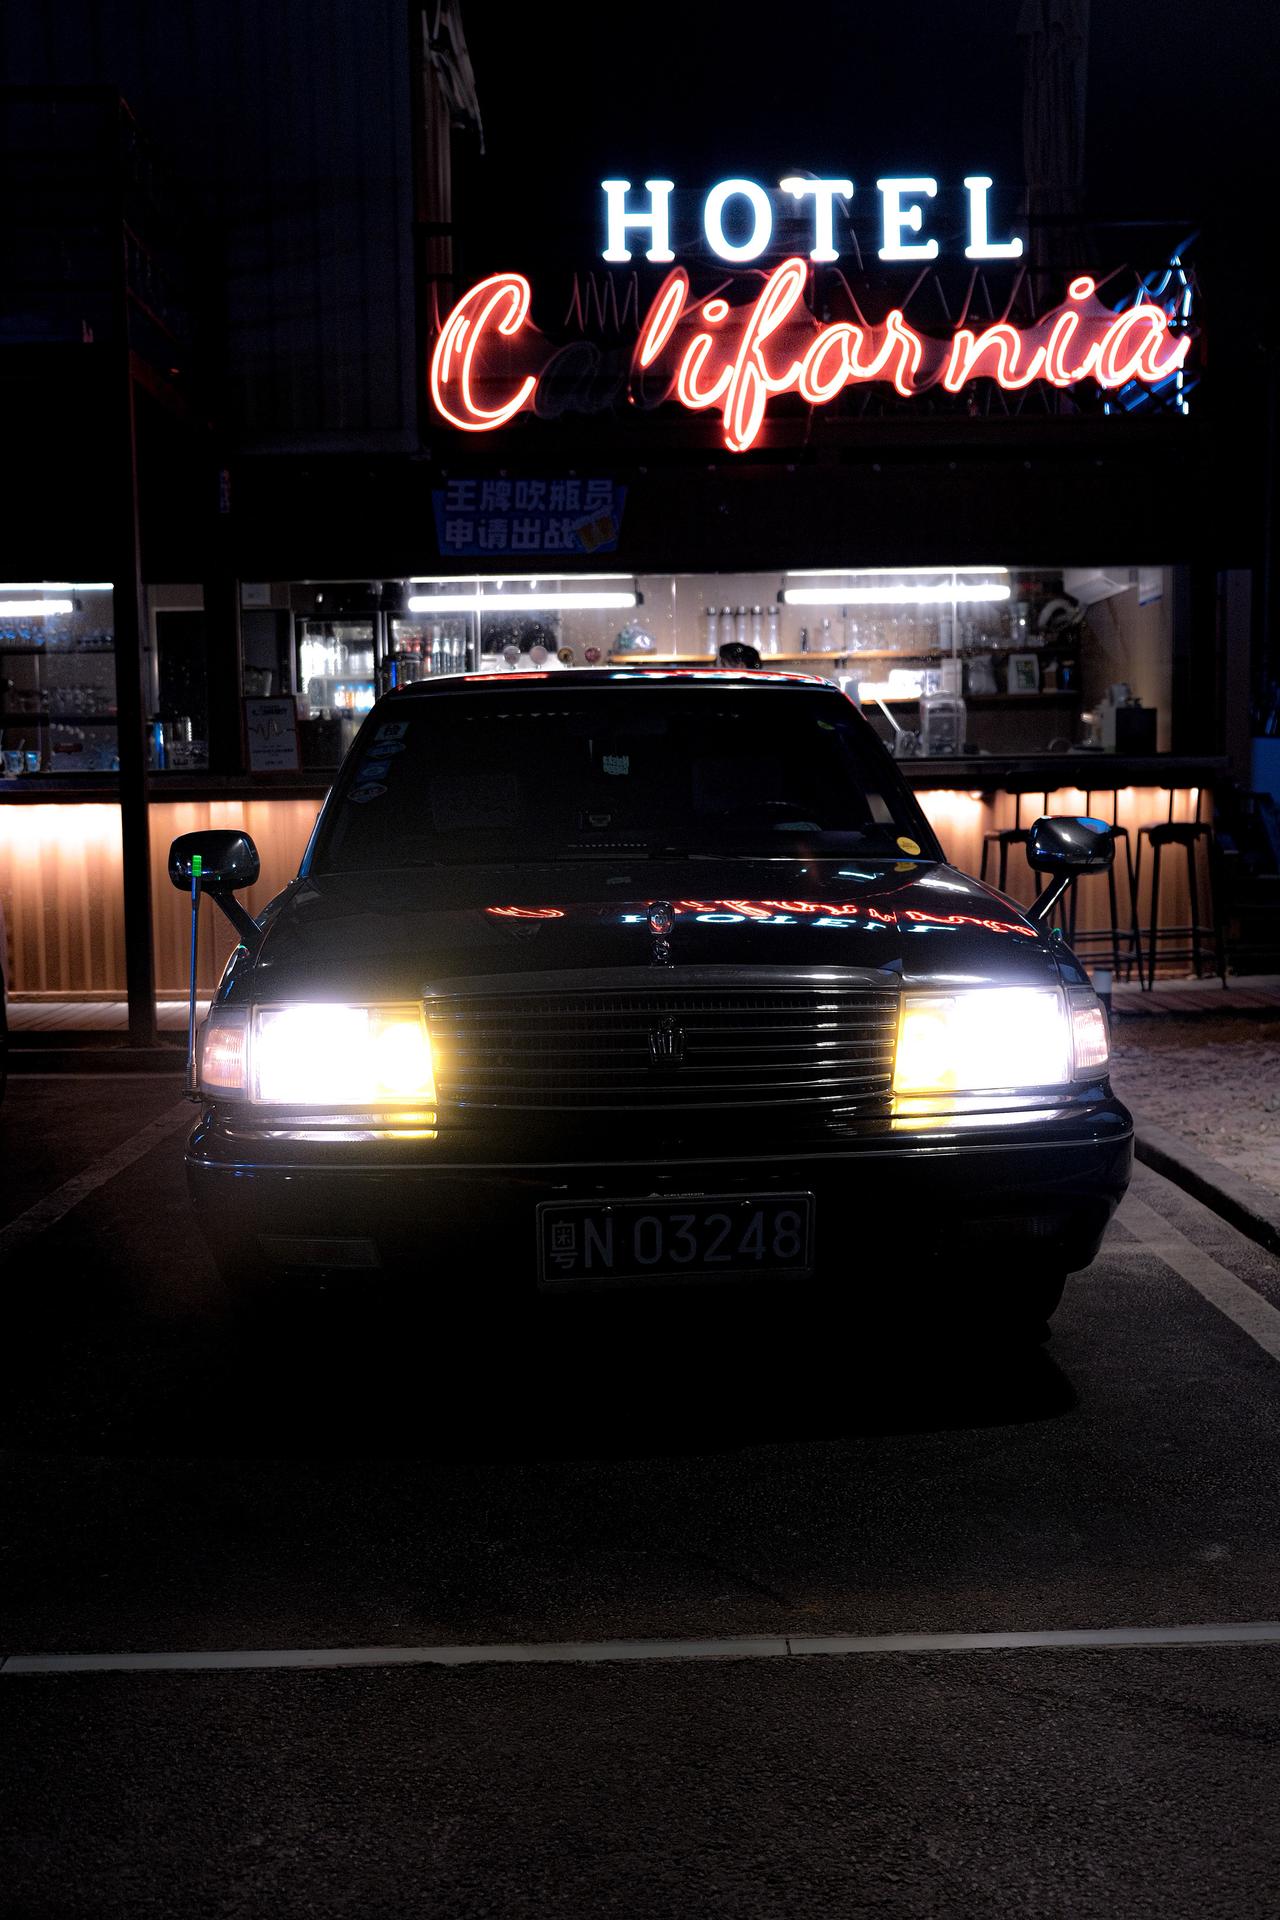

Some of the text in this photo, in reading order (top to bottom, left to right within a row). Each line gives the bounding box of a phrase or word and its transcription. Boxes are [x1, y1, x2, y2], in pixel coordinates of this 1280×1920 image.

[601, 177, 1024, 263] HOTEL
[445, 479, 614, 512] 王牌吹瓶员
[445, 517, 577, 550] 申请出战
[633, 1210, 802, 1266] 03248
